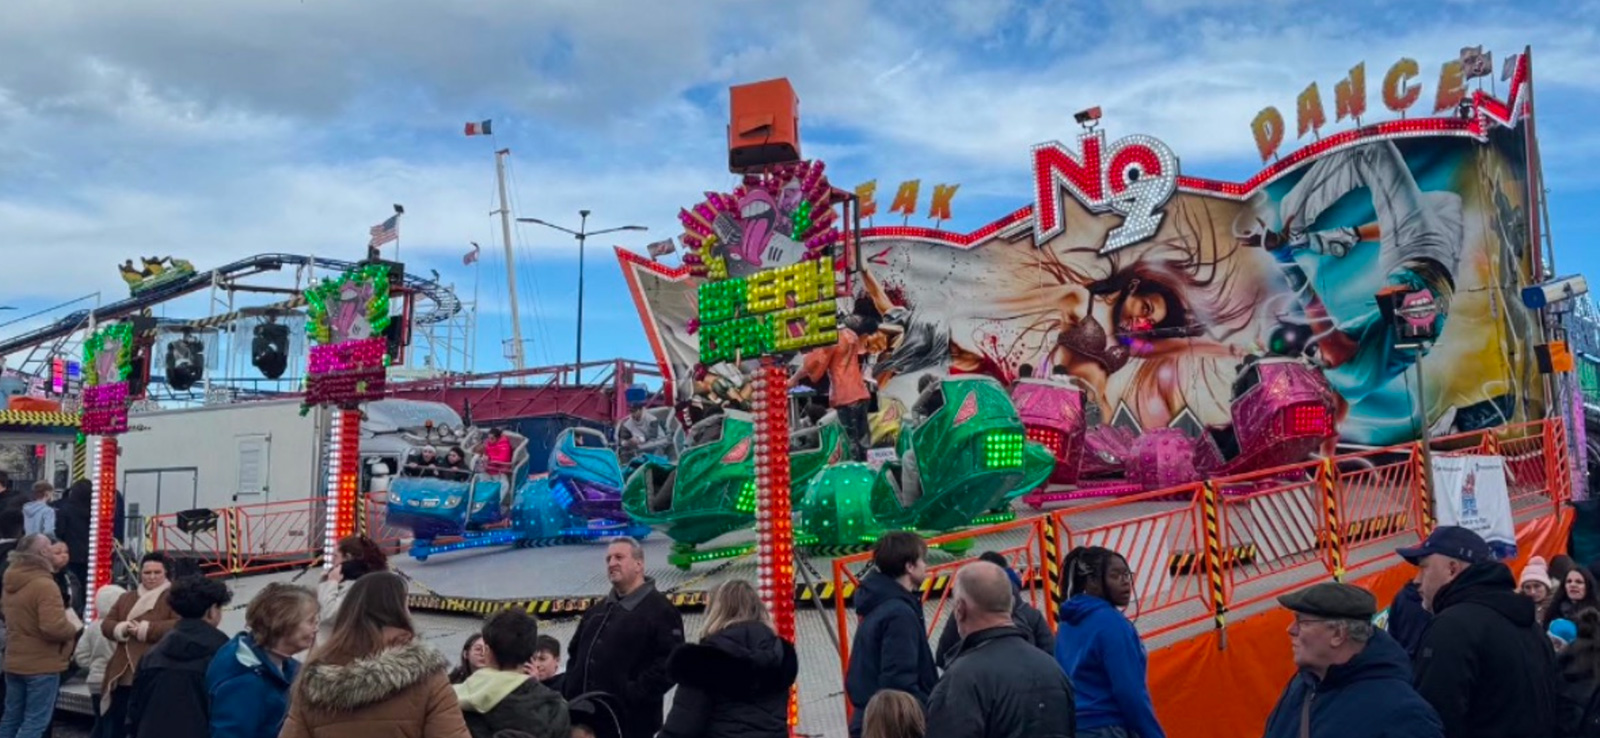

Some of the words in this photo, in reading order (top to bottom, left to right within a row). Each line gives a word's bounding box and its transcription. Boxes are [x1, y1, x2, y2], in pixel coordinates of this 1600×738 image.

[1250, 57, 1469, 163] DANCE
[698, 256, 835, 322] BREAK
[699, 300, 838, 363] DANCE
